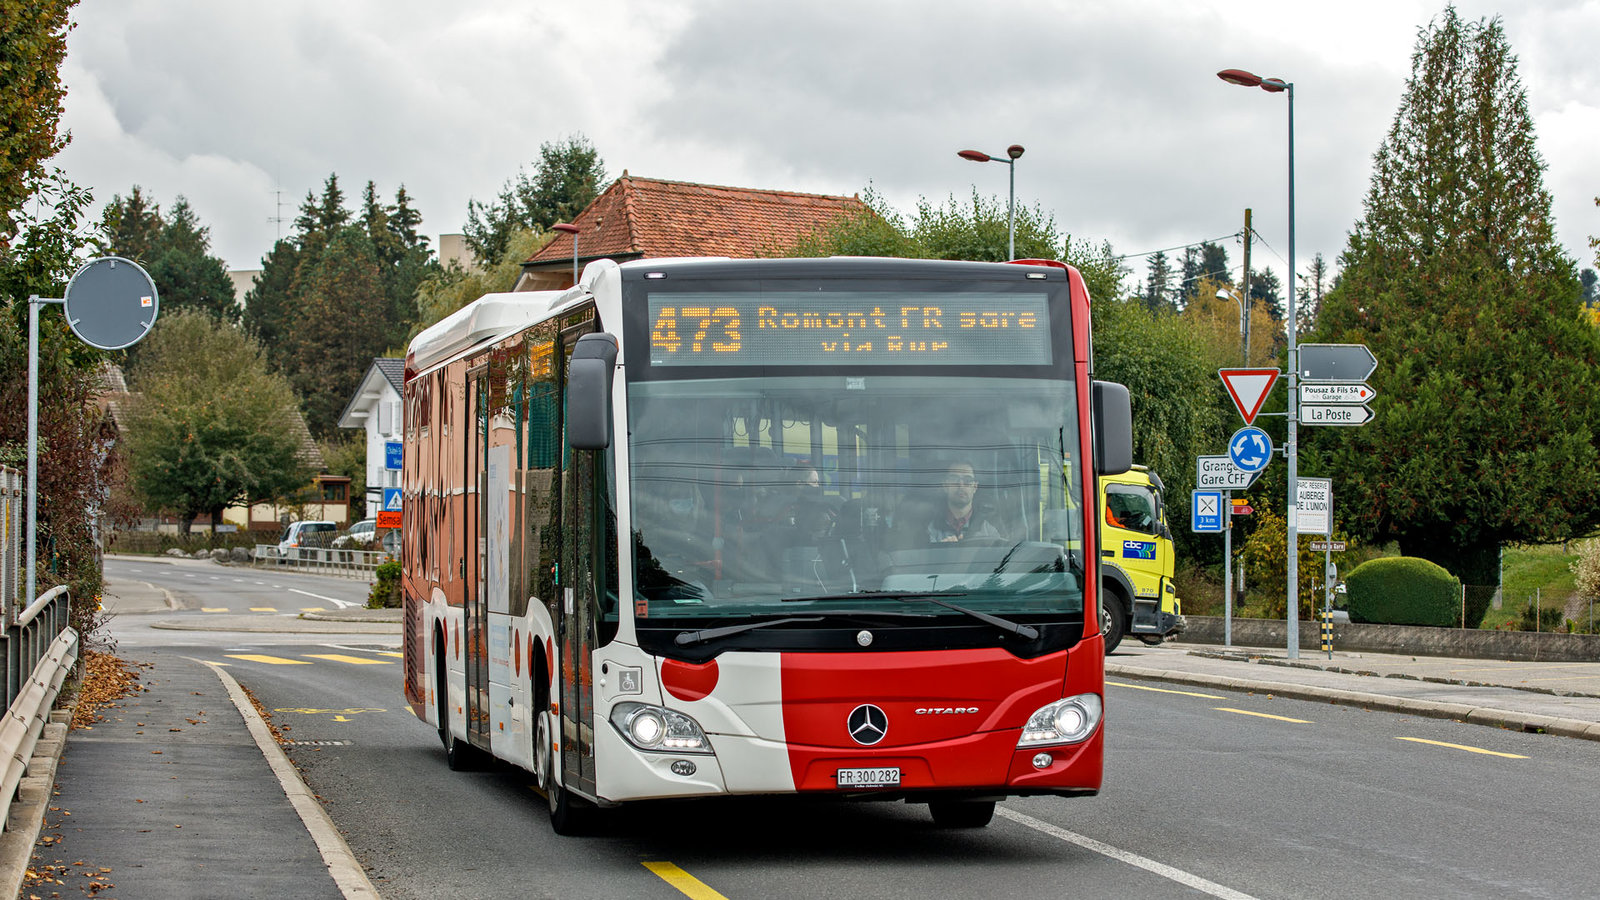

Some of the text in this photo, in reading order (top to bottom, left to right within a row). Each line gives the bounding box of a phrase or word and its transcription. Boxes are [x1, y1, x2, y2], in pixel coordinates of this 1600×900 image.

[652, 307, 741, 352] 473
[758, 306, 886, 328] Romont
[1311, 409, 1351, 420] La Poste
[1201, 473, 1245, 485] Gare CFF
[1299, 491, 1325, 501] AUBERGE
[1297, 501, 1328, 511] DE L'UNION
[1124, 541, 1141, 549] cbc
[914, 707, 979, 715] CITARO
[879, 769, 898, 783] 282
